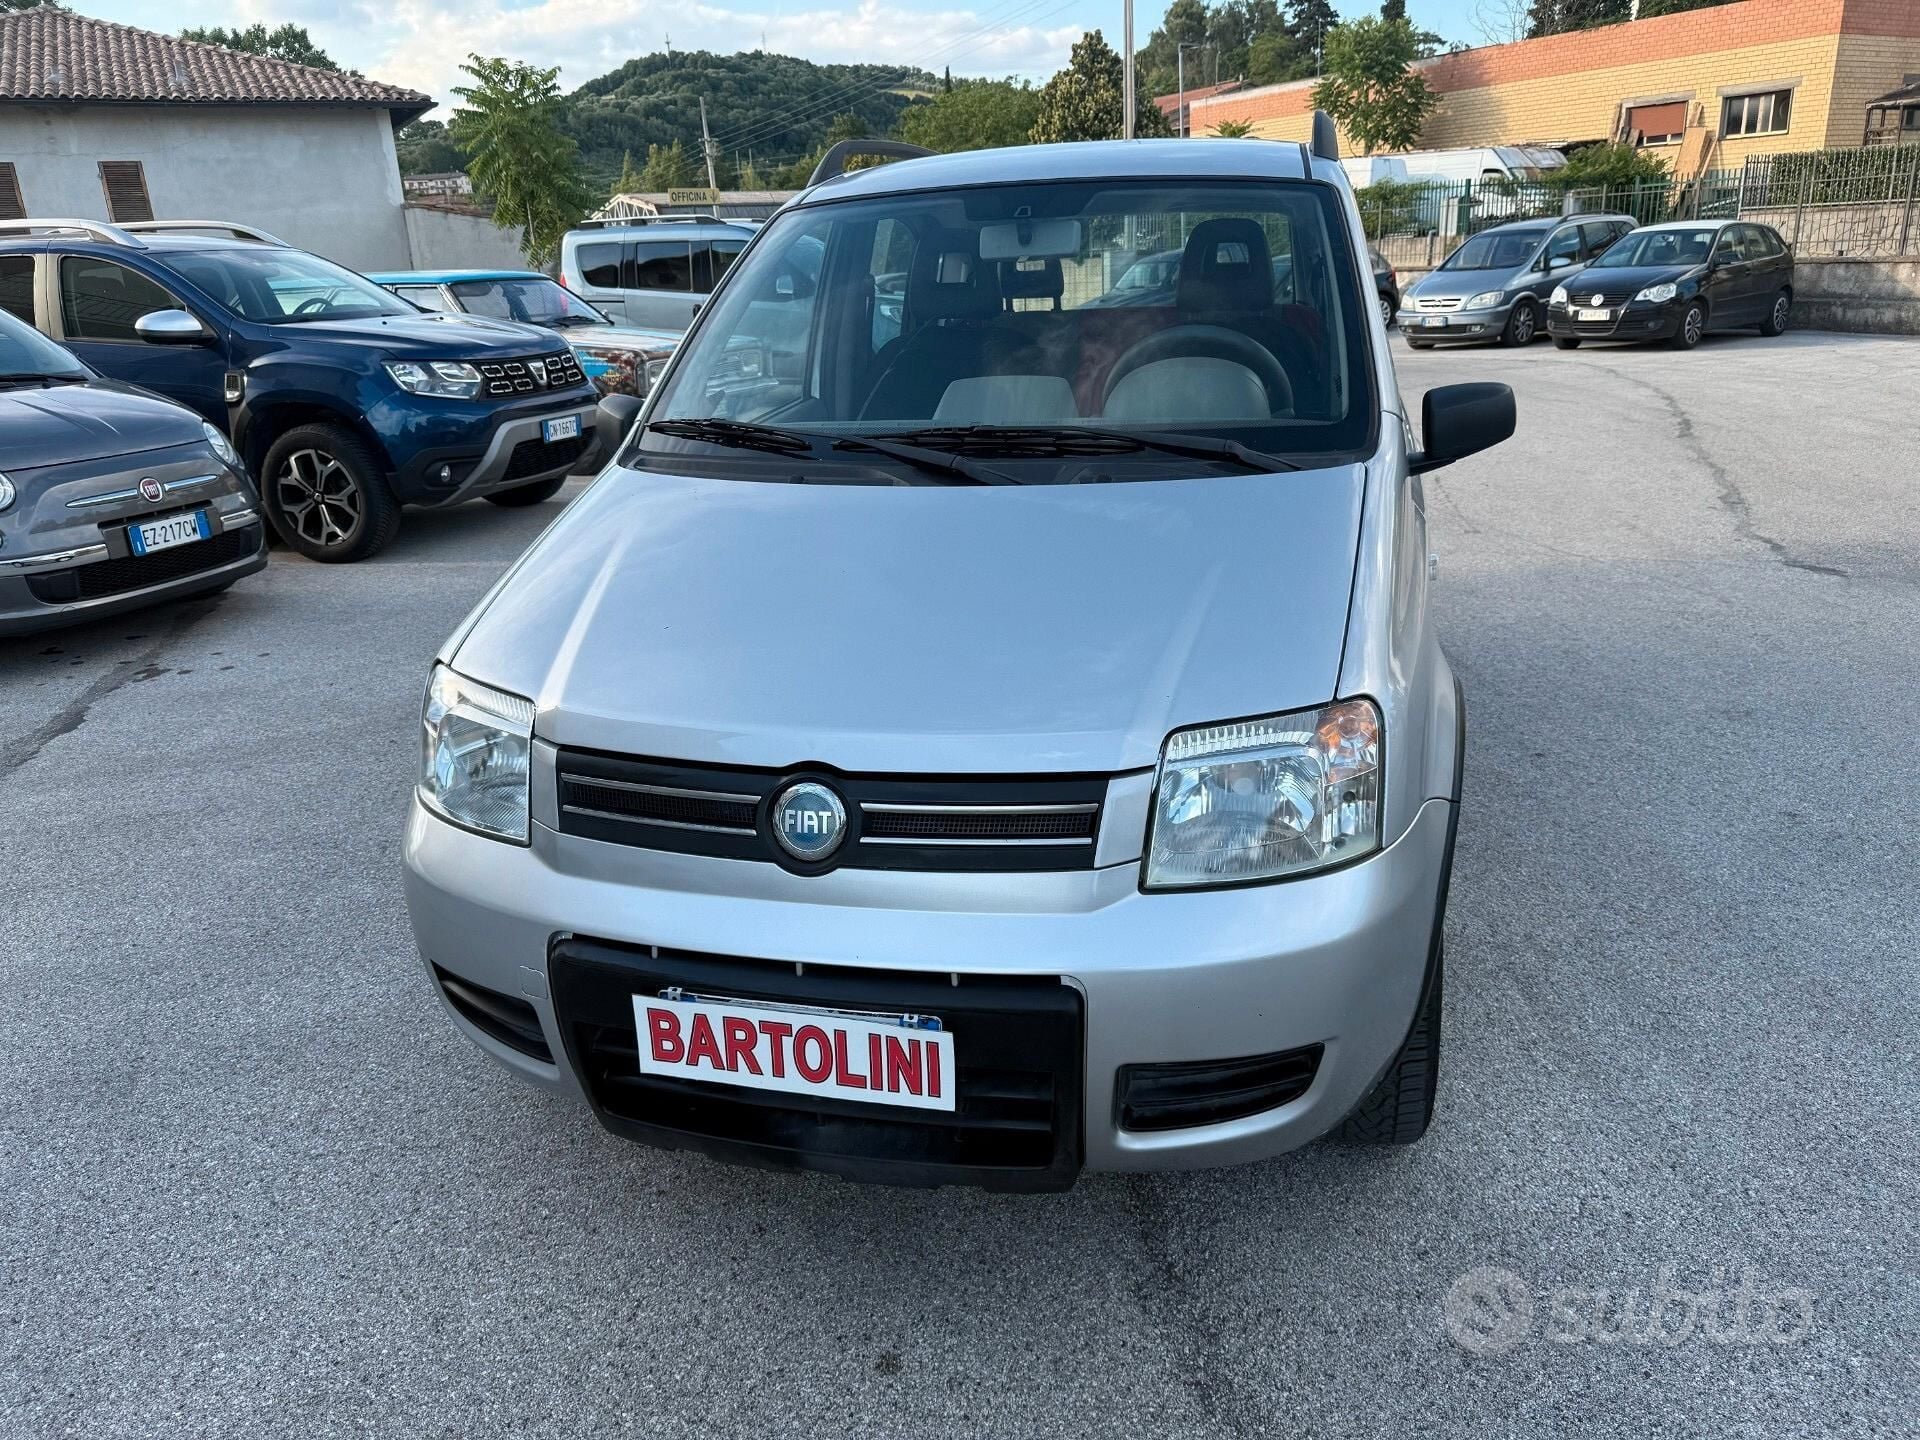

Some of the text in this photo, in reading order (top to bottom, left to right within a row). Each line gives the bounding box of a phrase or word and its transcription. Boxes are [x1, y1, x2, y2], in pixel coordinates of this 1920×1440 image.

[671, 191, 708, 202] OFFICINA
[784, 809, 832, 834] FIAT
[646, 1007, 942, 1098] BARTOLINI
